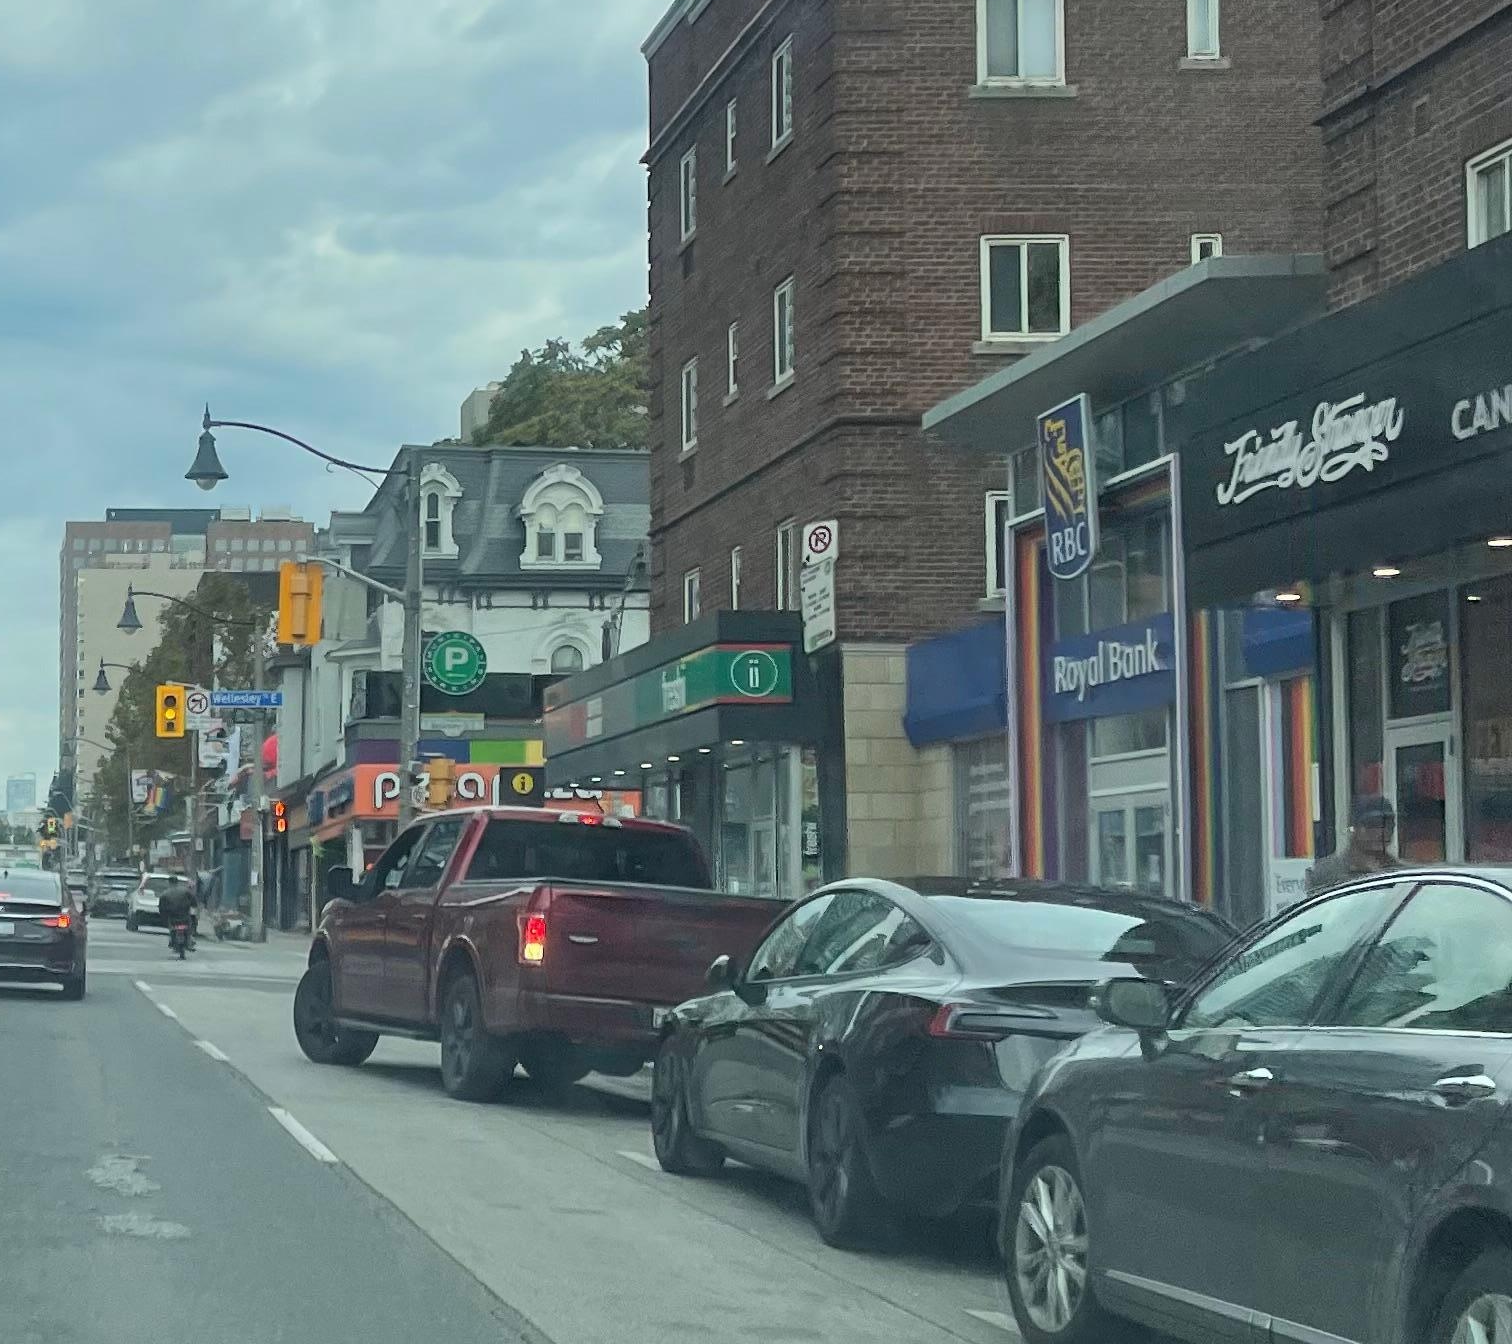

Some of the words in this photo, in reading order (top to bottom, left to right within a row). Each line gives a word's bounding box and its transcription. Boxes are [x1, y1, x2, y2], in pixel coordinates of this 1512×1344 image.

[1051, 521, 1088, 566] RBC
[1054, 640, 1105, 702] Royal
[1108, 628, 1160, 682] Bank
[213, 692, 262, 707] Wellesley
